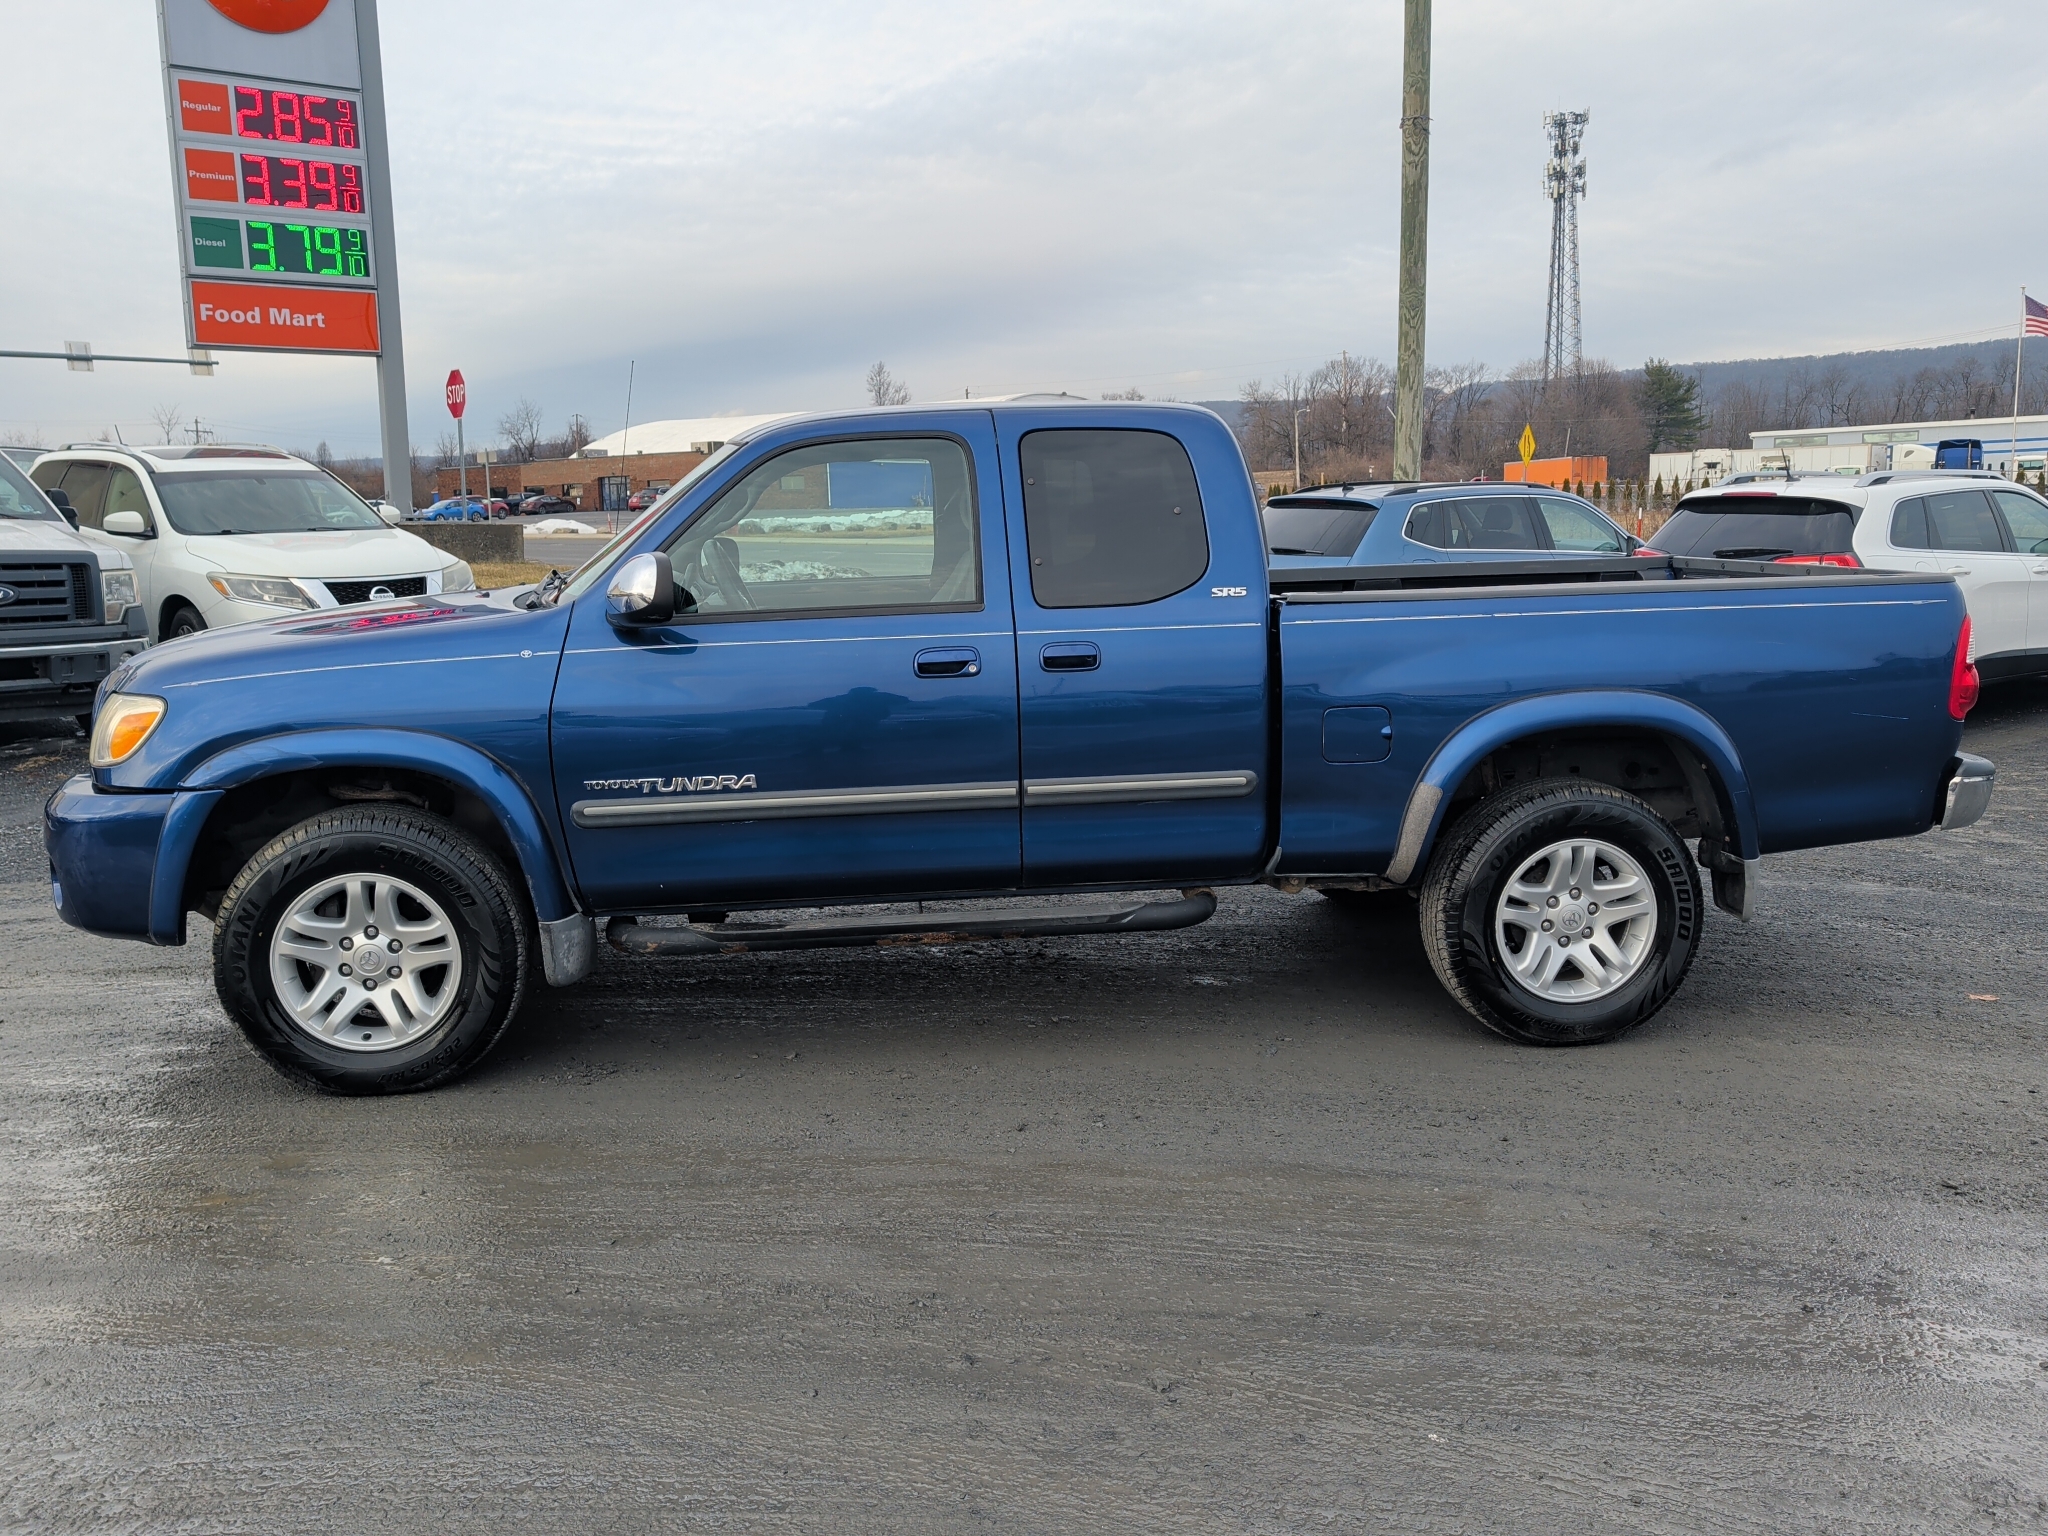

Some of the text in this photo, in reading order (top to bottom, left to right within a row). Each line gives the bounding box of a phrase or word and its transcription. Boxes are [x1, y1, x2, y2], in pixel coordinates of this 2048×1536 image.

[182, 99, 222, 112] Regular
[236, 86, 333, 146] 2.85
[188, 169, 235, 182] Premium
[242, 154, 338, 211] 3.39
[194, 237, 226, 247] Diesel
[247, 221, 343, 276] 3.79
[199, 303, 326, 328] Food Mart
[447, 384, 465, 404] STOP
[1211, 586, 1247, 598] SR5
[583, 773, 758, 794] TOYOTA TUNDRA
[1656, 846, 1692, 941] SA1000
[231, 897, 262, 984] OTANI
